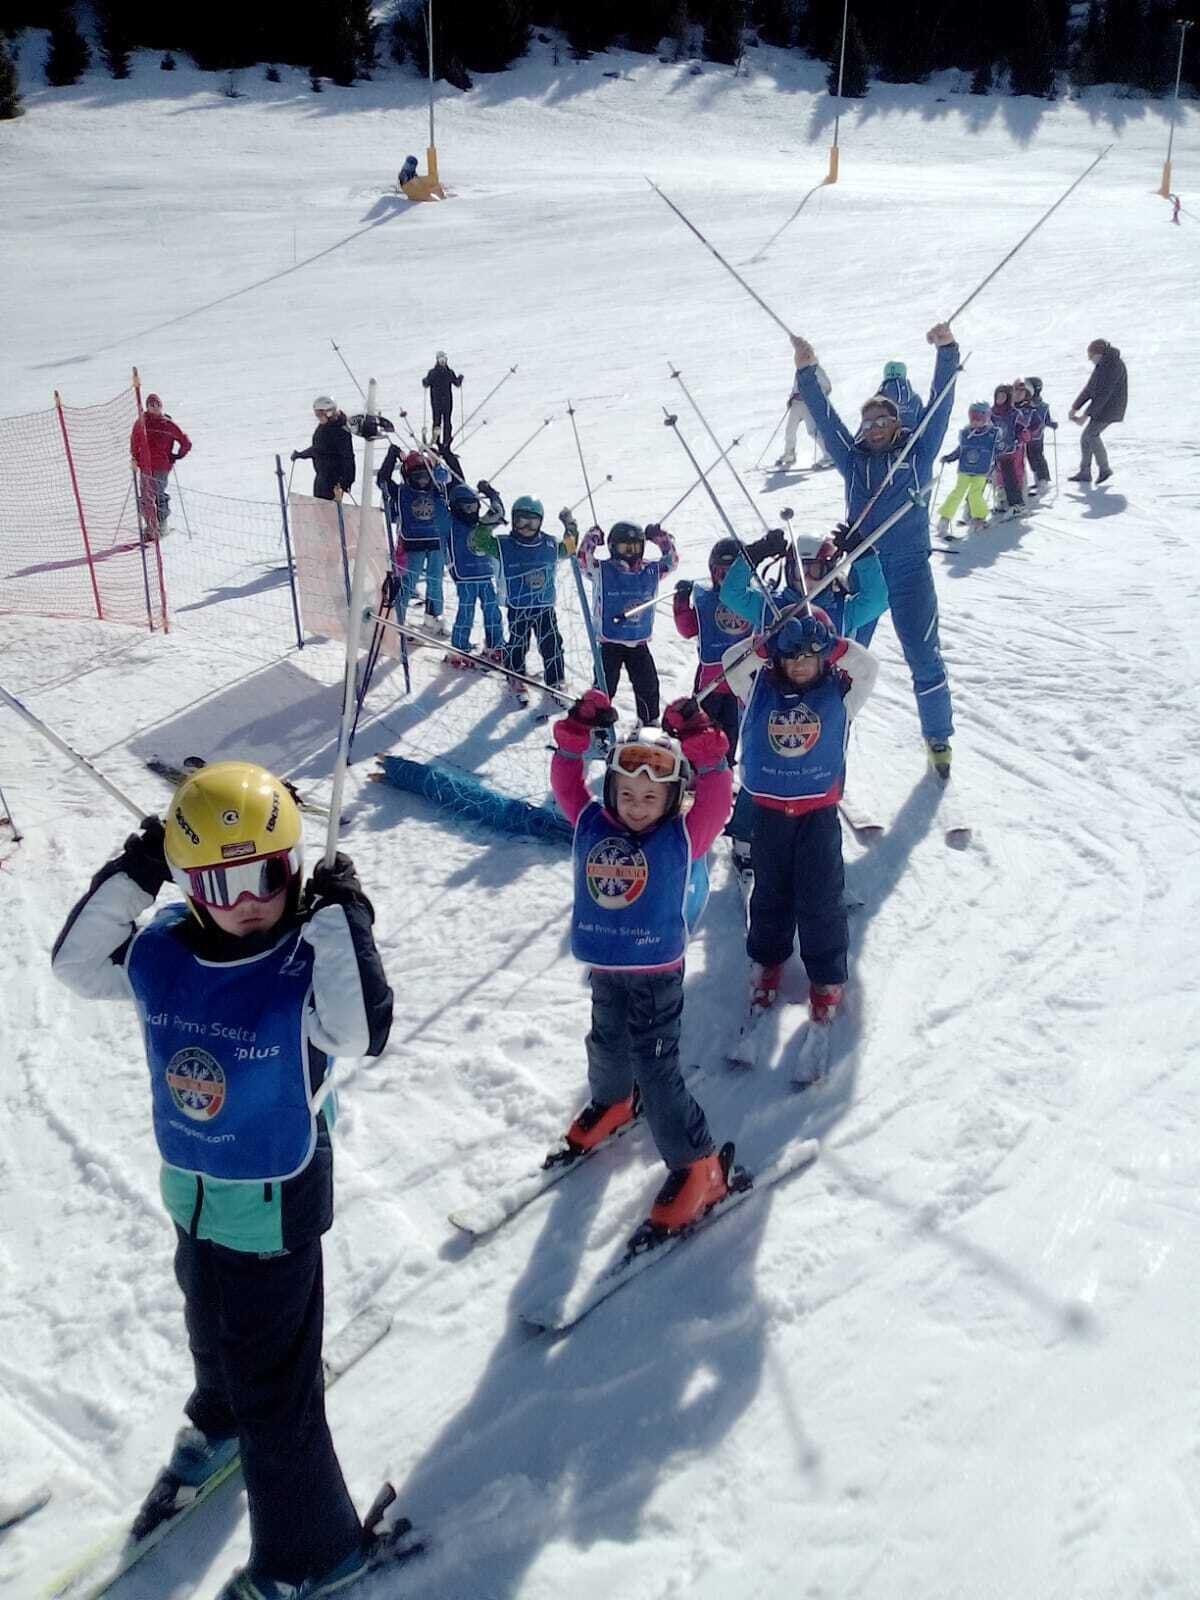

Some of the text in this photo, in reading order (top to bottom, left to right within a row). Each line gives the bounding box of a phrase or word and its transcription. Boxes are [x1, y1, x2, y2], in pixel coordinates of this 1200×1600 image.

[145, 1012, 169, 1026] udi
[210, 1022, 257, 1042] Scelta
[233, 1045, 281, 1060] :plus
